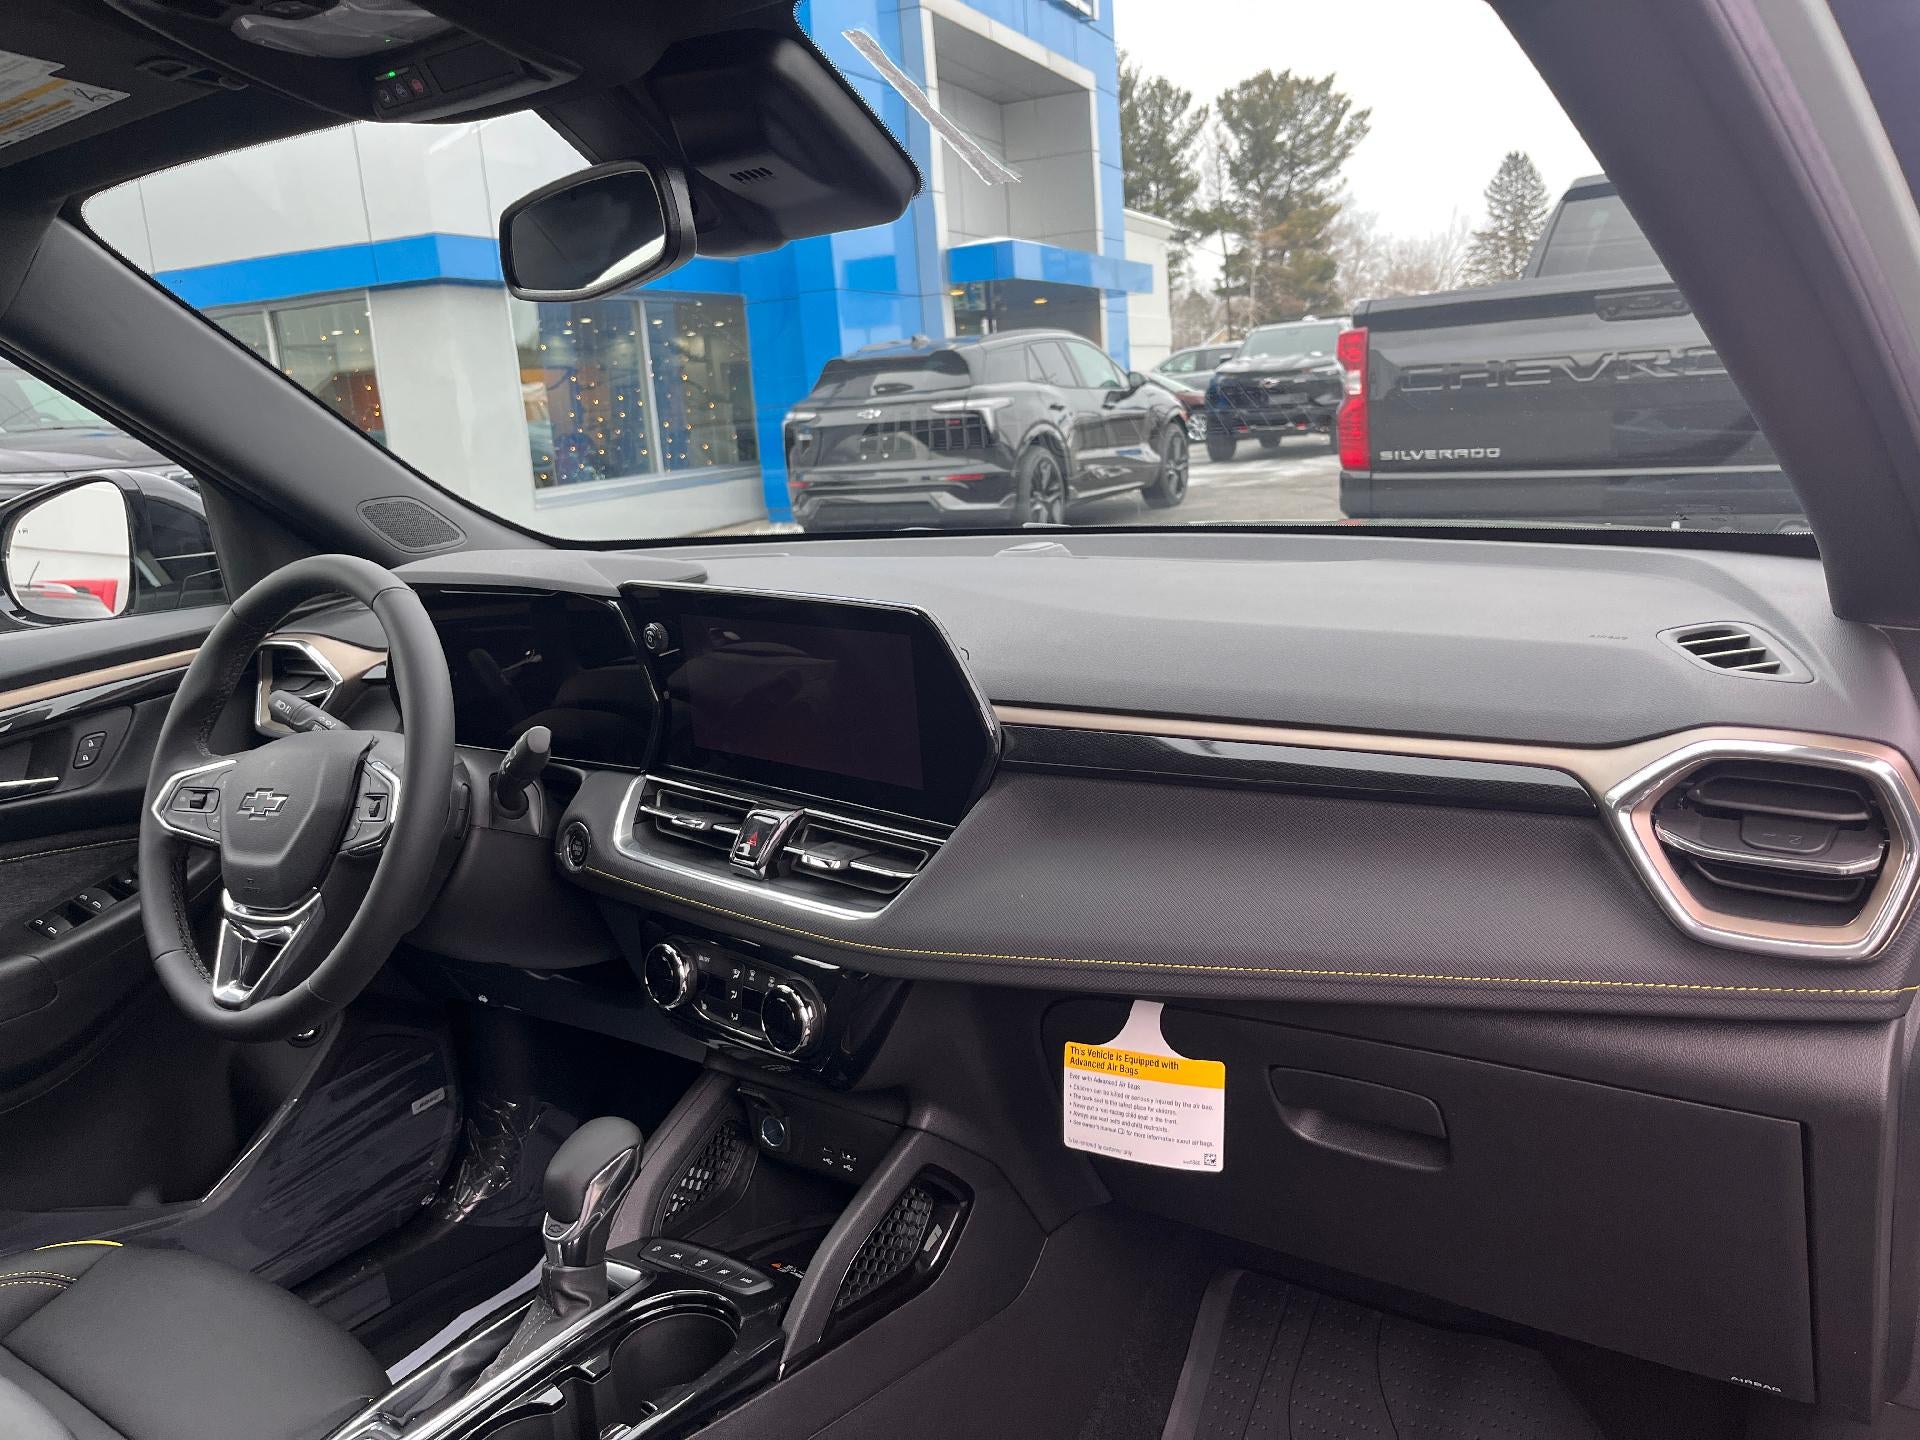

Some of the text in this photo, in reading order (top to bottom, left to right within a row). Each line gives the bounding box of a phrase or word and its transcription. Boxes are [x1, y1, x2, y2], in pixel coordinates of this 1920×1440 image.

[1379, 447, 1501, 461] SILVERADO
[1070, 1046, 1179, 1071] This Vehicle is Equipped with
[1070, 1057, 1139, 1076] Advanced Air Bags
[1730, 1376, 1782, 1393] AIRBAG
